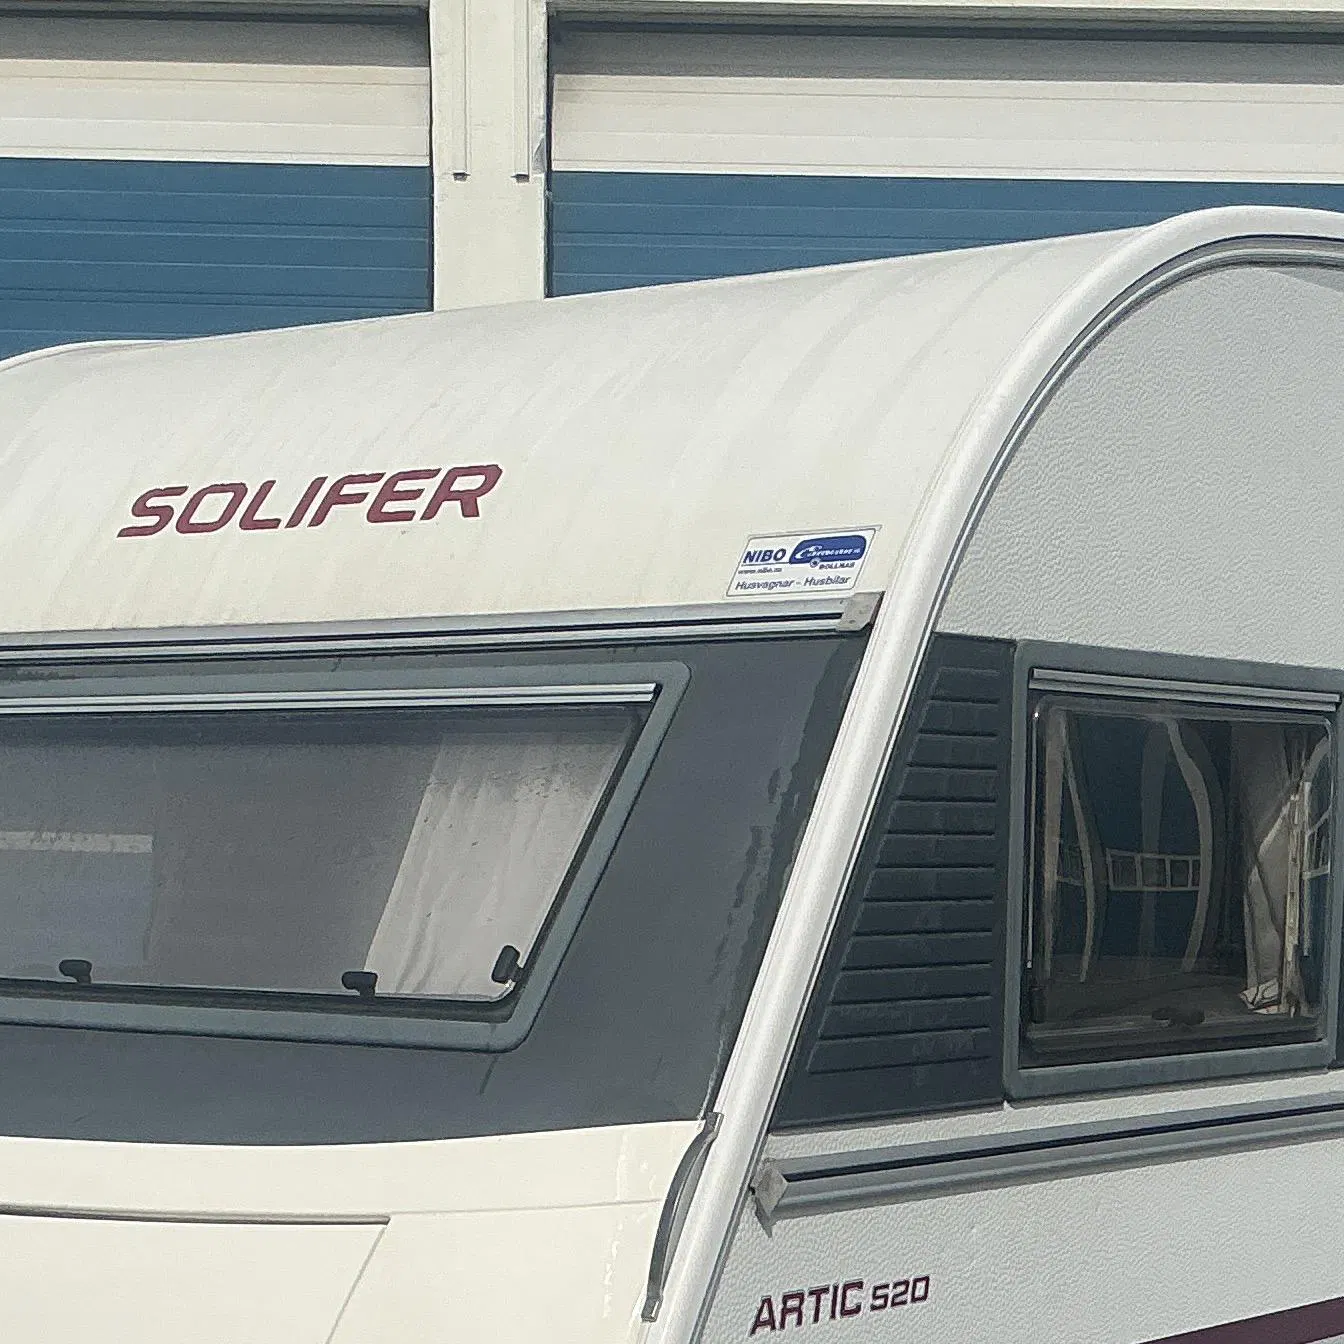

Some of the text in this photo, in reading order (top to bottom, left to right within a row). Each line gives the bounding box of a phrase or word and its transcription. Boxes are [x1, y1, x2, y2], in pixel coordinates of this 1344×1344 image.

[116, 463, 504, 539] SOLIFER
[742, 547, 787, 564] NIBO
[734, 578, 795, 591] Husvagnar
[803, 574, 852, 587] Husbilar
[749, 1274, 931, 1337] ARTIC 520
